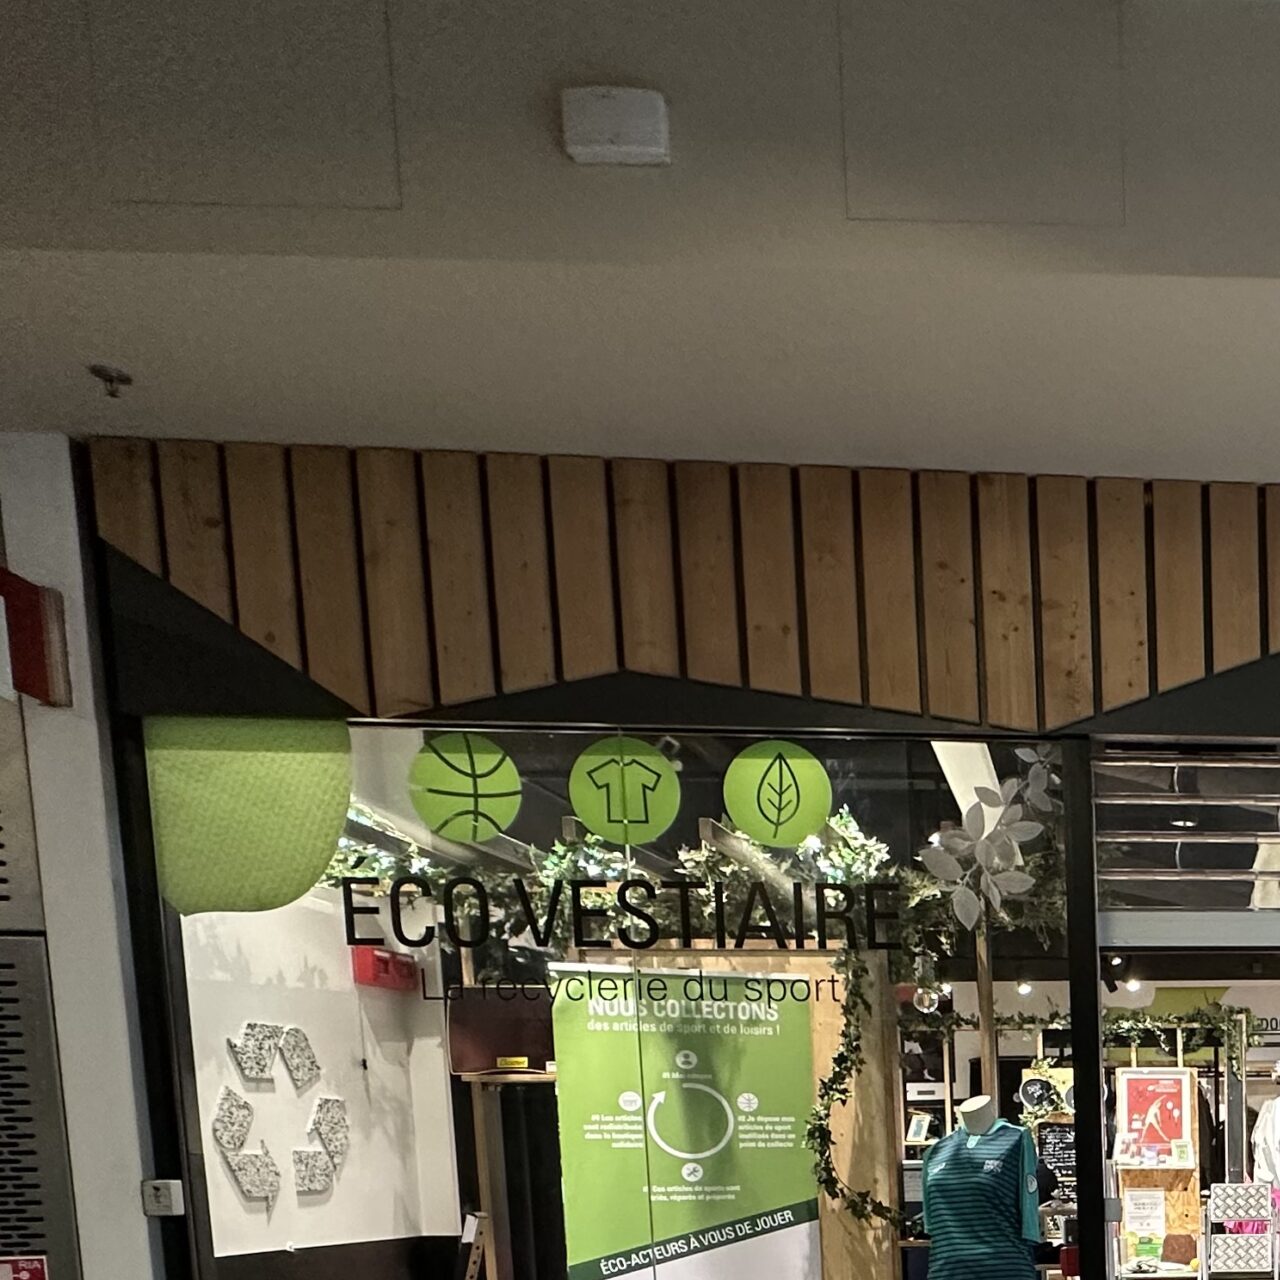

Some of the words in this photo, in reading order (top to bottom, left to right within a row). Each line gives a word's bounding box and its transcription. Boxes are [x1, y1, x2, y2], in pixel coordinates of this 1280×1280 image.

[341, 857, 489, 949] ÉCO
[513, 878, 900, 950] VESTIAIRE
[421, 967, 463, 1001] La
[484, 969, 667, 1013] recyclerie
[684, 970, 728, 1002] du
[745, 974, 841, 1009] sport
[588, 998, 647, 1018] NOUS
[653, 1000, 778, 1021] COLLECTONS
[587, 1020, 610, 1032] des
[612, 1020, 656, 1033] articles
[660, 1022, 674, 1033] de
[677, 1023, 706, 1036] sport
[710, 1024, 720, 1034] et
[724, 1024, 737, 1034] de
[740, 1024, 773, 1036] loisirs
[689, 1234, 701, 1249] À
[699, 1226, 735, 1246] VOUS
[737, 1222, 752, 1236] DE
[755, 1210, 795, 1232] JOUER
